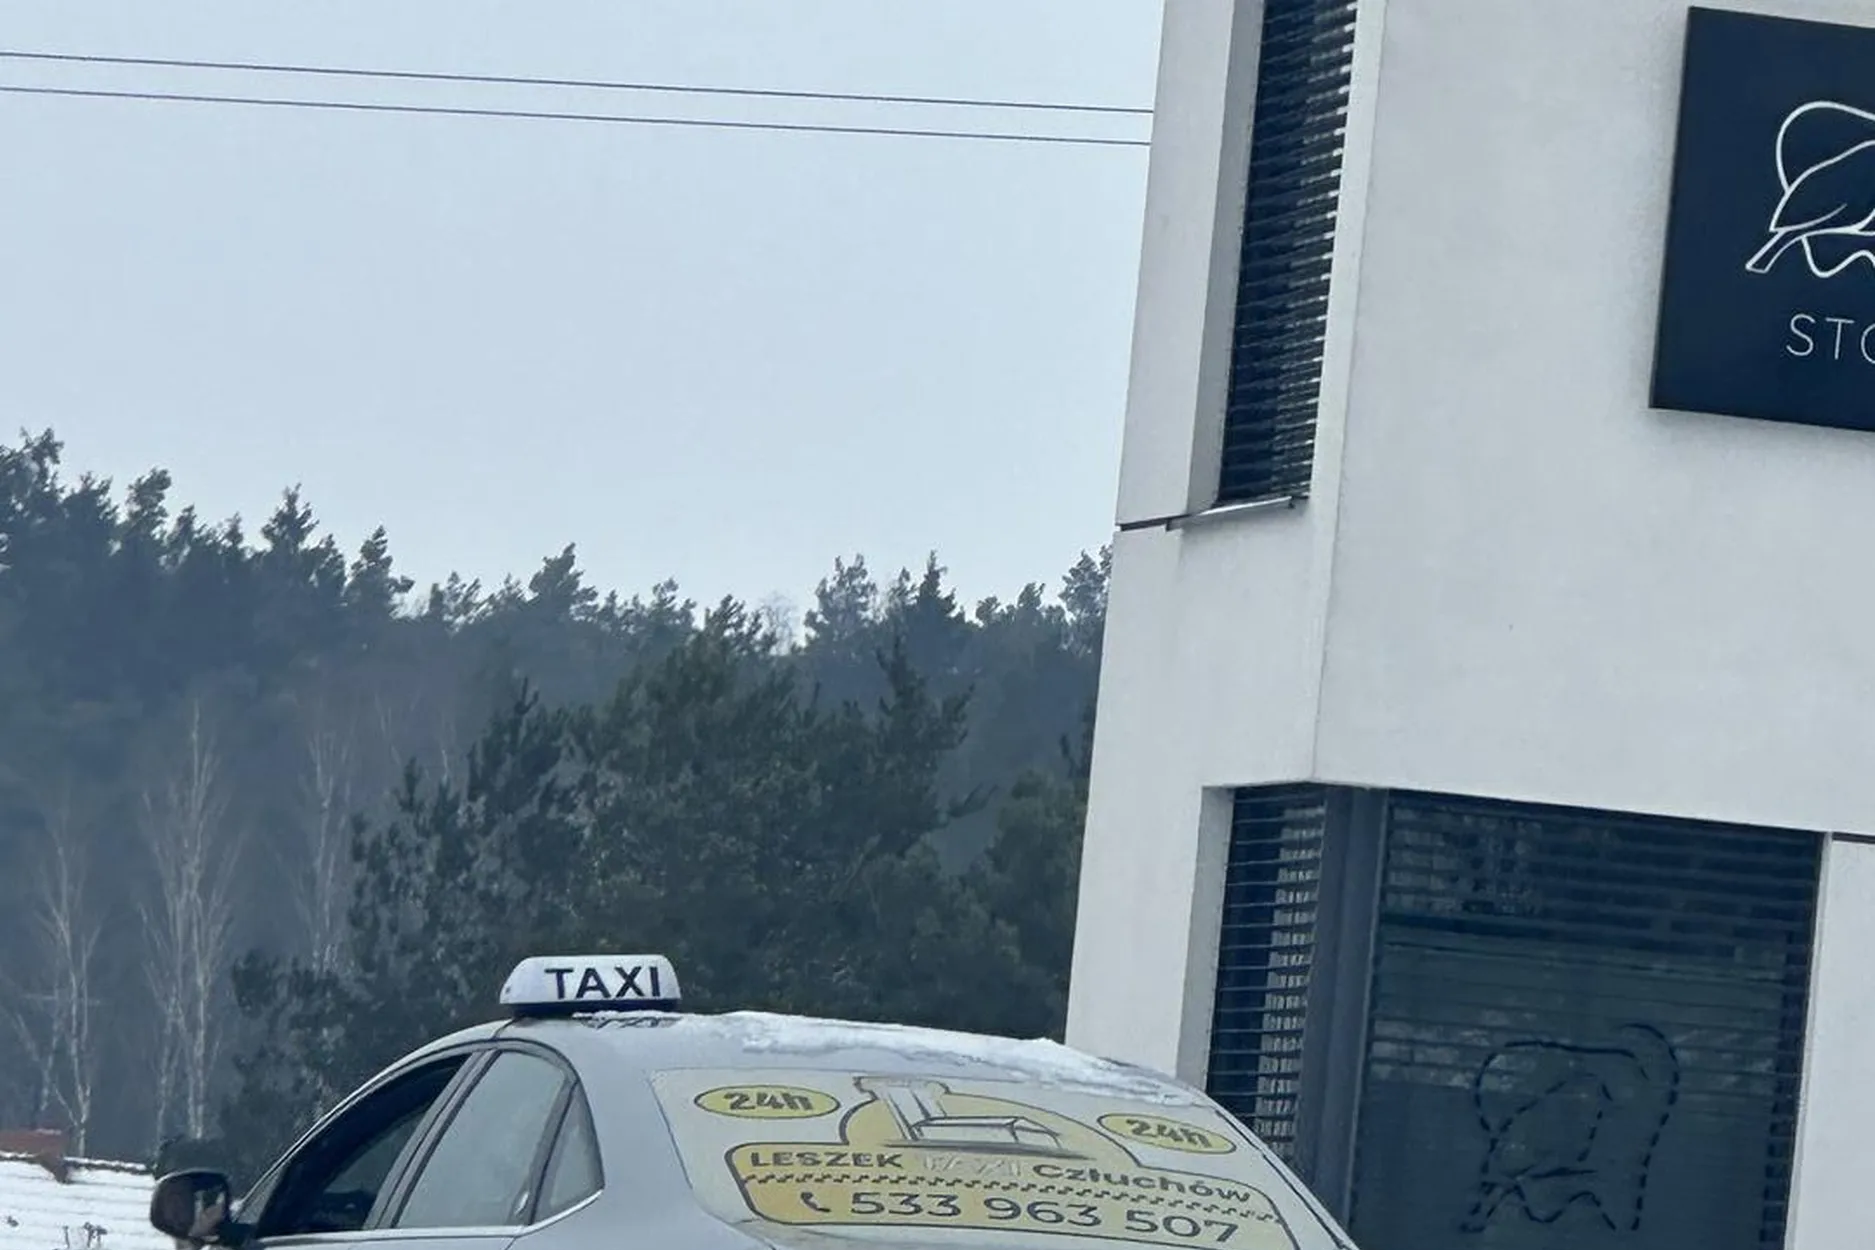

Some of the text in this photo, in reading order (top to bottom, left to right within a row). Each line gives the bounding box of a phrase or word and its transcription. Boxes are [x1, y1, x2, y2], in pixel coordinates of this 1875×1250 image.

[544, 965, 661, 1000] TAXI
[723, 1091, 814, 1112] 24h
[1125, 1118, 1213, 1149] 24h
[750, 1151, 904, 1168] LESZEK
[1032, 1163, 1251, 1204] Człuchów
[850, 1191, 1239, 1243] 533 963 507
